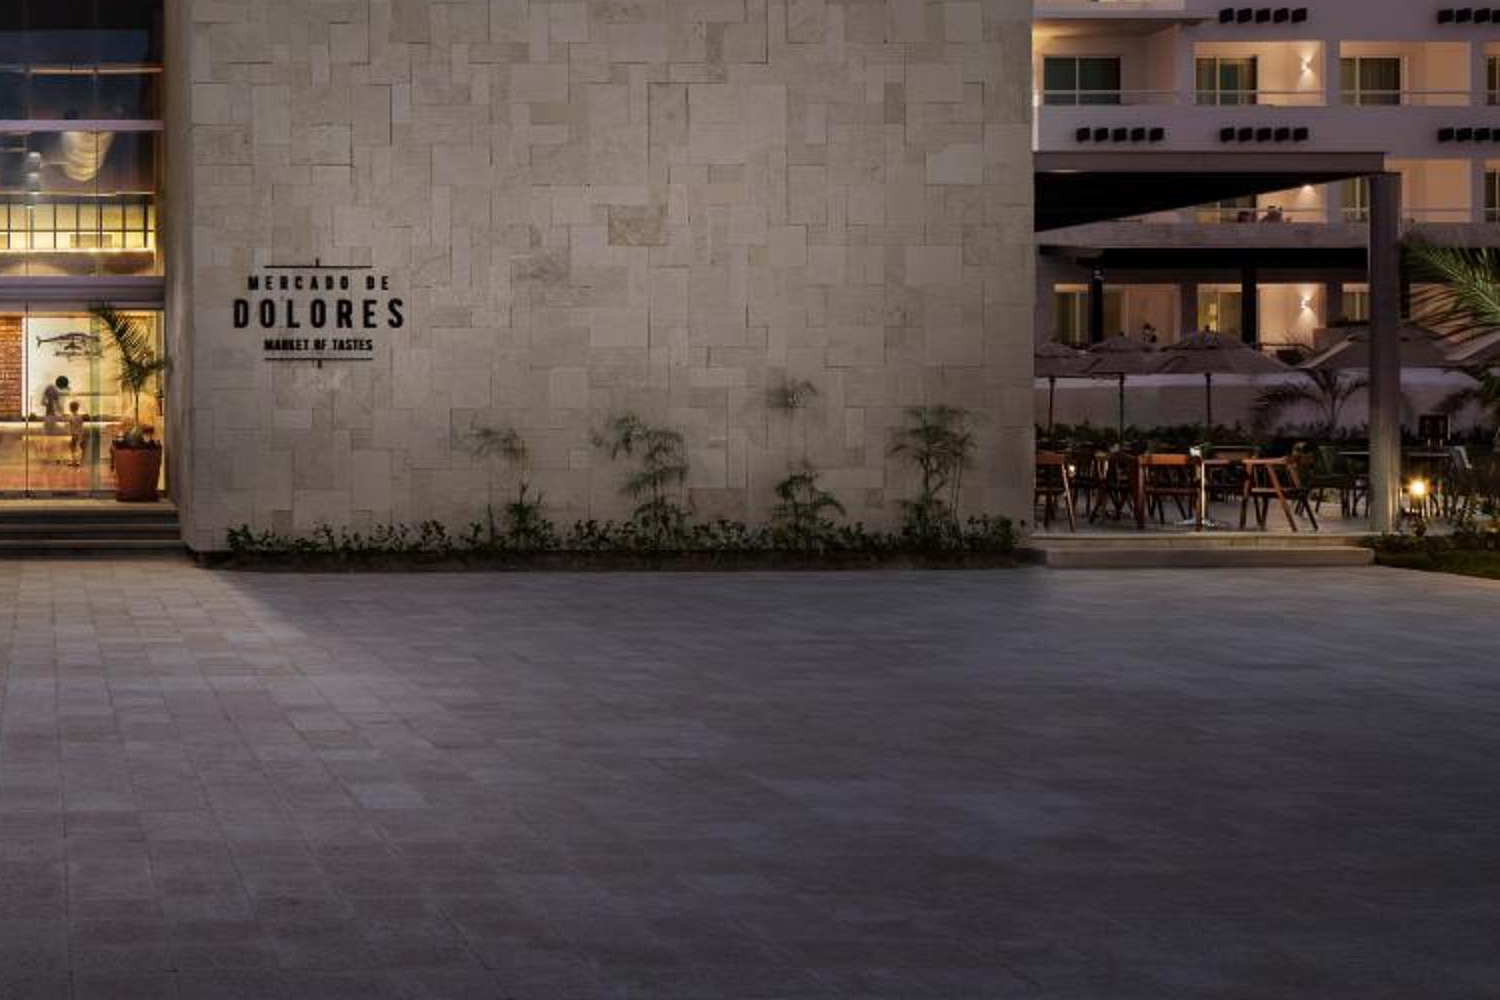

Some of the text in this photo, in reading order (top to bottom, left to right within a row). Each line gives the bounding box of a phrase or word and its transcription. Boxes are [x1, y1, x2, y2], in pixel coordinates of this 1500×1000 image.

[247, 275, 389, 290] MERCADO DE
[233, 298, 404, 329] DOLORES
[264, 339, 372, 351] MARKET OF TASTES
